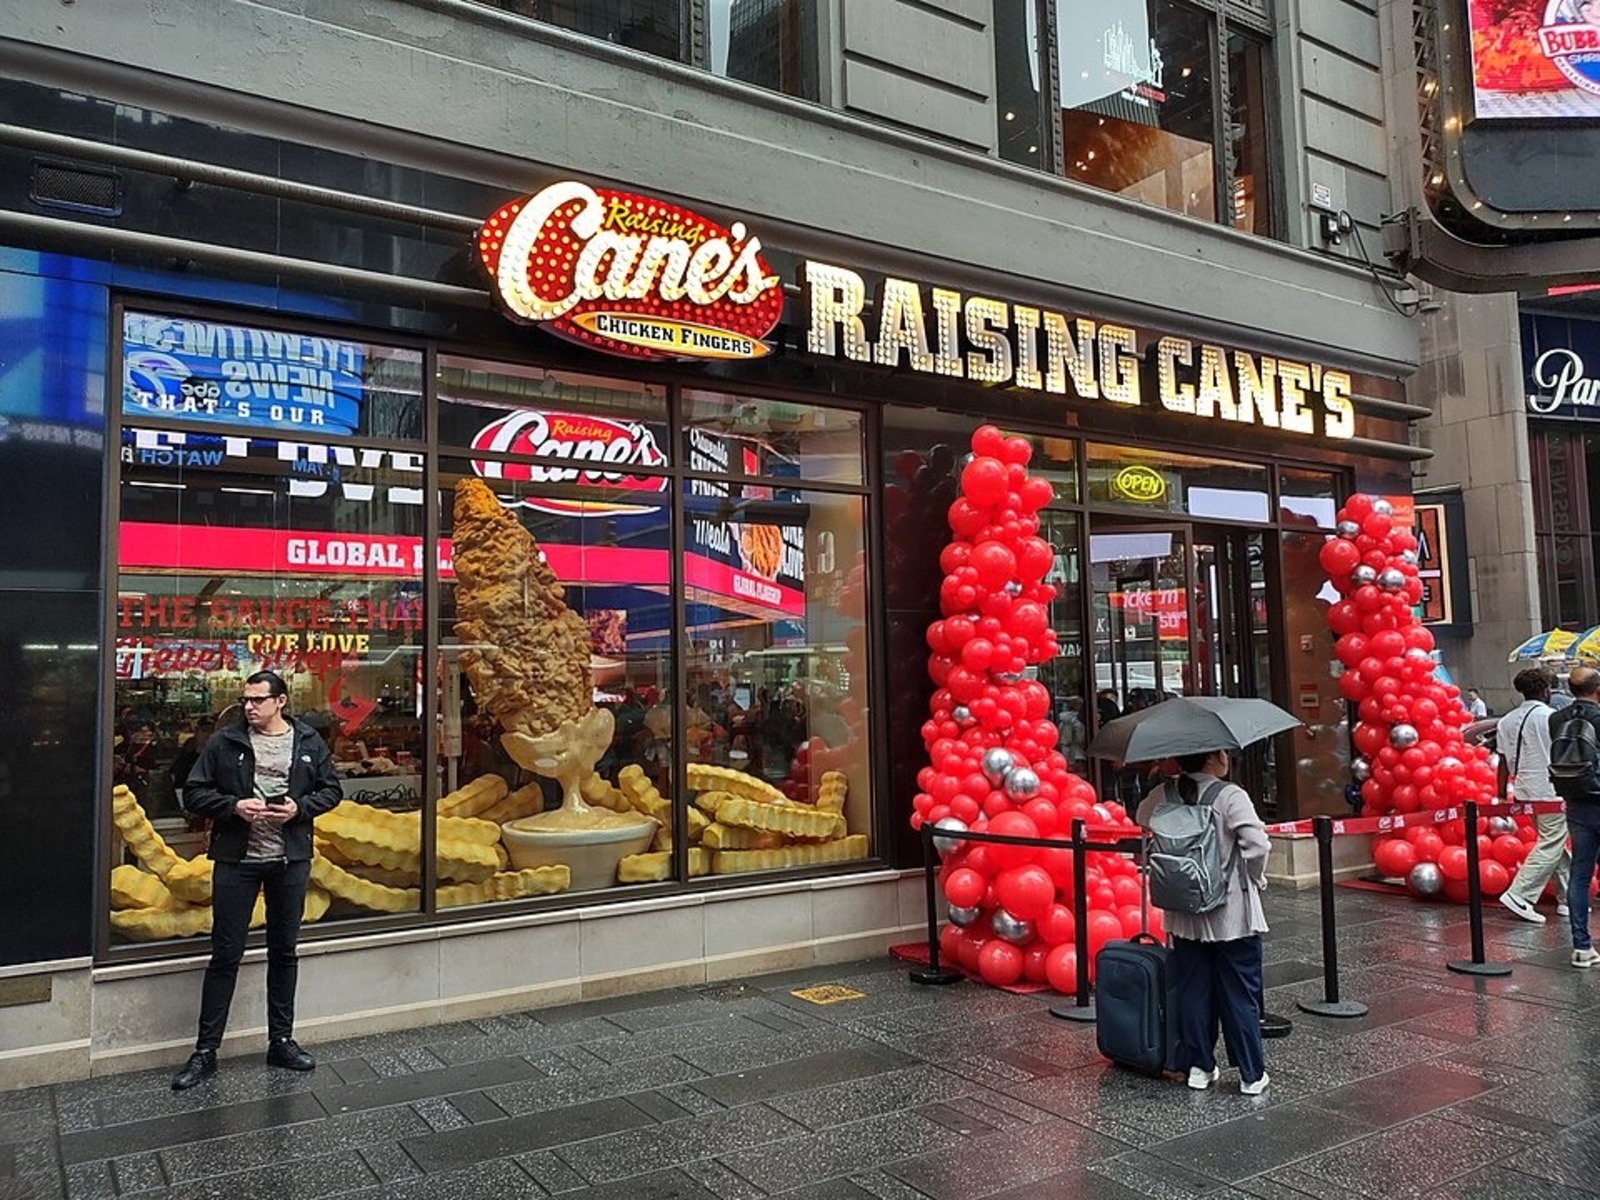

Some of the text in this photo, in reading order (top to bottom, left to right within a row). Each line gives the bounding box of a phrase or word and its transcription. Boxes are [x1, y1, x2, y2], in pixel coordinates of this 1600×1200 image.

[605, 202, 702, 247] Raising
[498, 181, 781, 321] Cane's
[597, 315, 752, 355] CHICKEN FINGERS
[804, 260, 1356, 439] RAISING CANE'S
[137, 391, 325, 426] THAT'S OUR
[483, 410, 662, 484] Cane's
[552, 419, 613, 444] Raising
[1121, 473, 1159, 494] OPEN
[287, 538, 405, 568] GLOBAL
[118, 596, 197, 629] THE
[209, 597, 331, 630] SAUCE
[306, 633, 371, 654] LOVE
